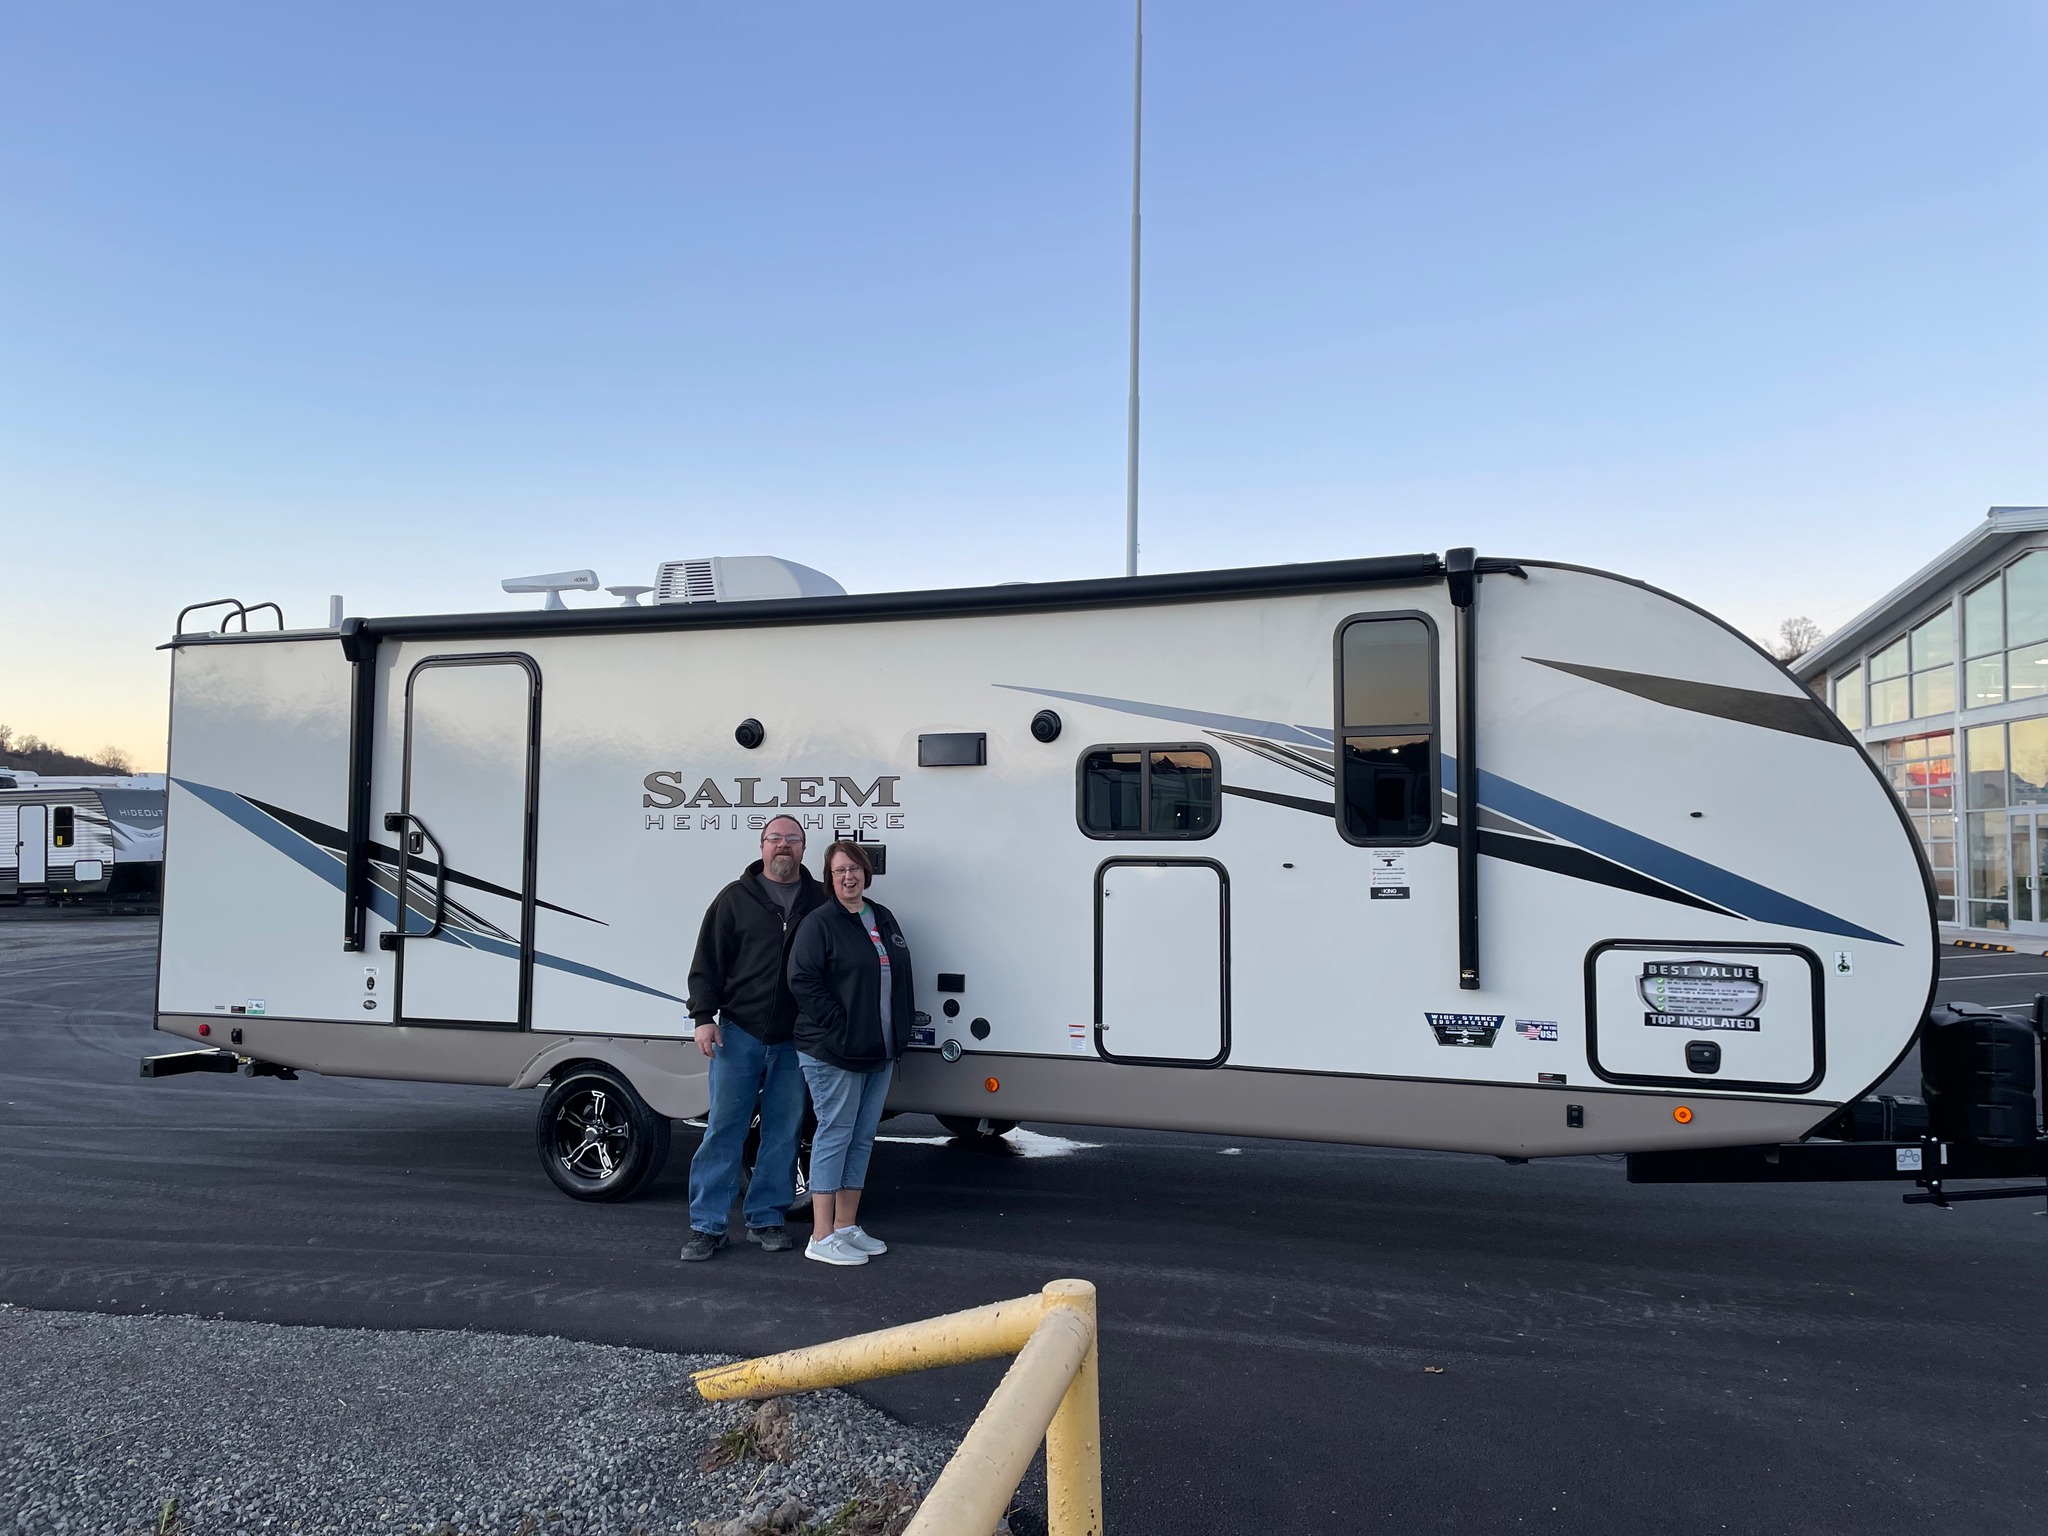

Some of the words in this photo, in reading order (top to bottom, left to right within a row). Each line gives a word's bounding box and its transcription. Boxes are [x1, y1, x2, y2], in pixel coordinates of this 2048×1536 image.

[643, 771, 900, 809] SALEM
[119, 809, 163, 817] HIDEOUT
[645, 813, 905, 830] HEMISHERE
[834, 830, 880, 842] HL
[1648, 964, 1690, 976] BEST
[1700, 966, 1754, 978] VALUE
[1432, 1019, 1495, 1027] SUSPENSION
[1649, 1014, 1676, 1025] TOP
[1680, 1016, 1755, 1029] INSULATED
[1540, 1030, 1557, 1039] USA
